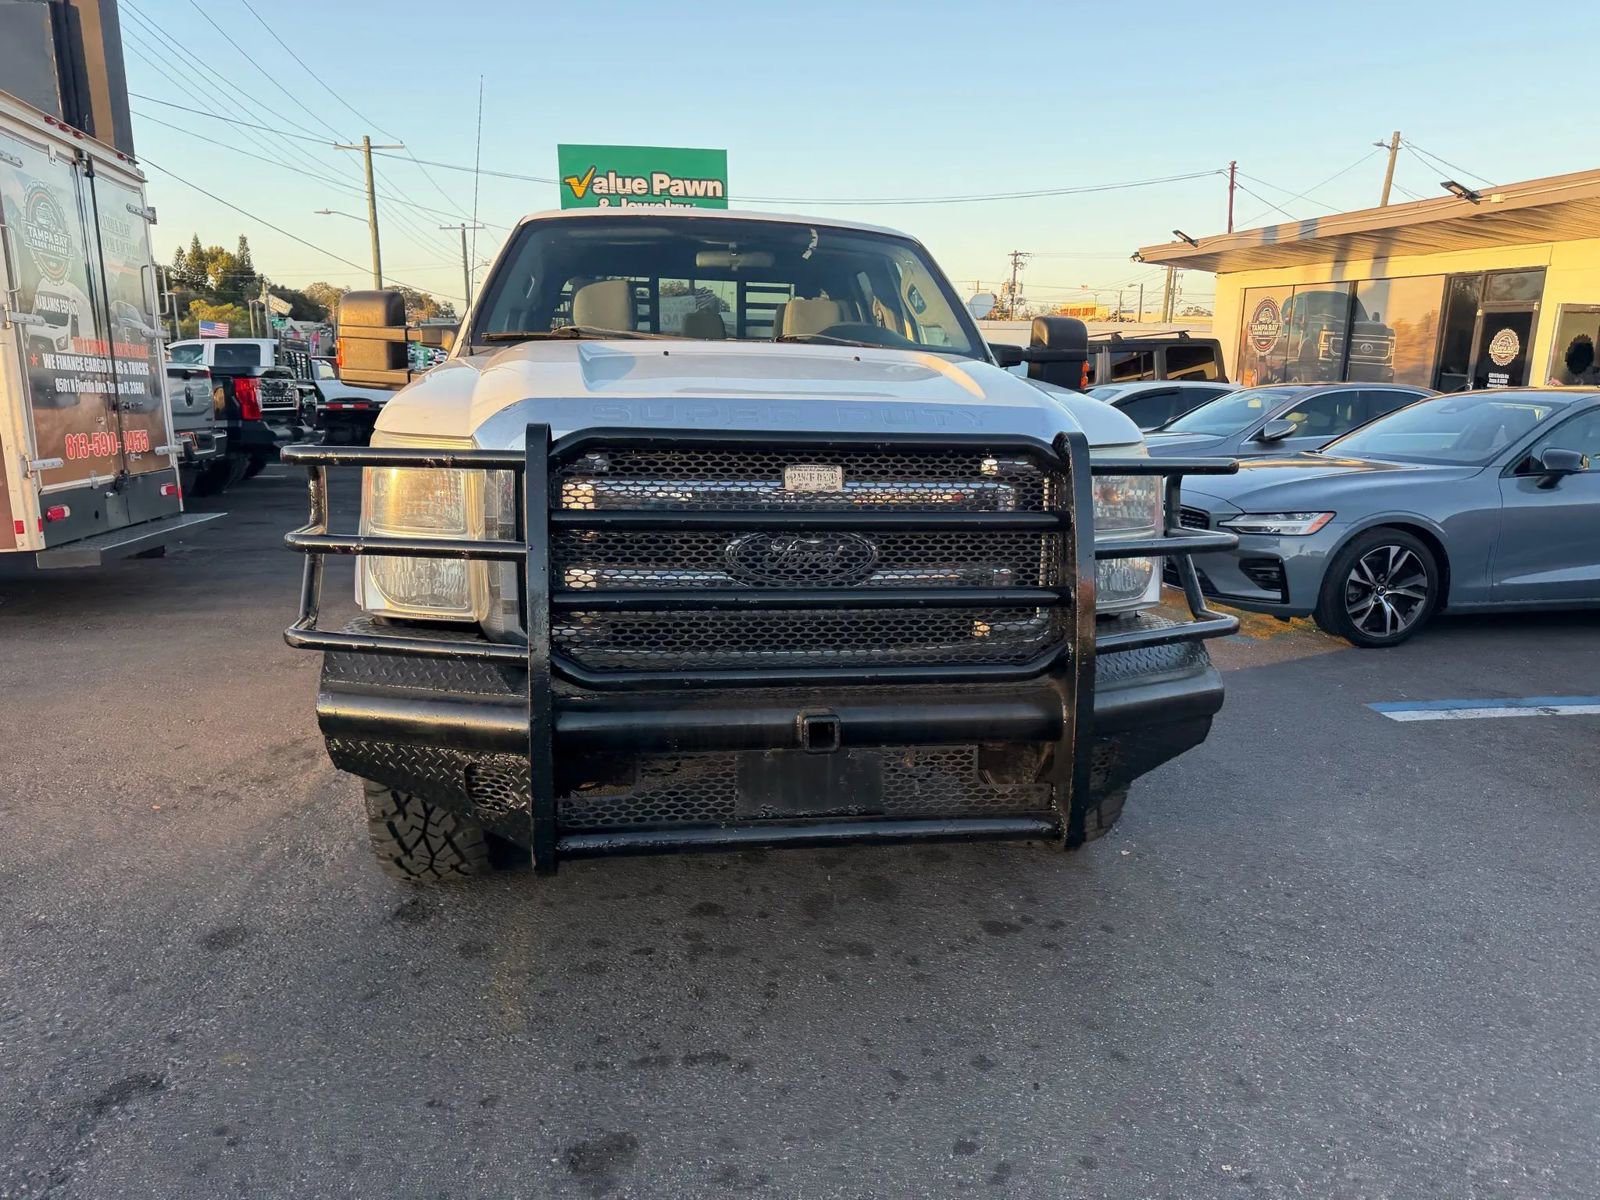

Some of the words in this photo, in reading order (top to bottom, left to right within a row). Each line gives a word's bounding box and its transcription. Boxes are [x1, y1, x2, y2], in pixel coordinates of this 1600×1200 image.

[652, 172, 723, 198] Pawn
[42, 353, 56, 369] WE
[56, 355, 84, 371] FINANCE
[107, 359, 123, 375] VNS
[128, 361, 149, 376] TRUCKS
[55, 377, 70, 392] 8501
[75, 375, 95, 396] Florida
[592, 404, 801, 425] SUPER
[835, 406, 993, 427] DUTY
